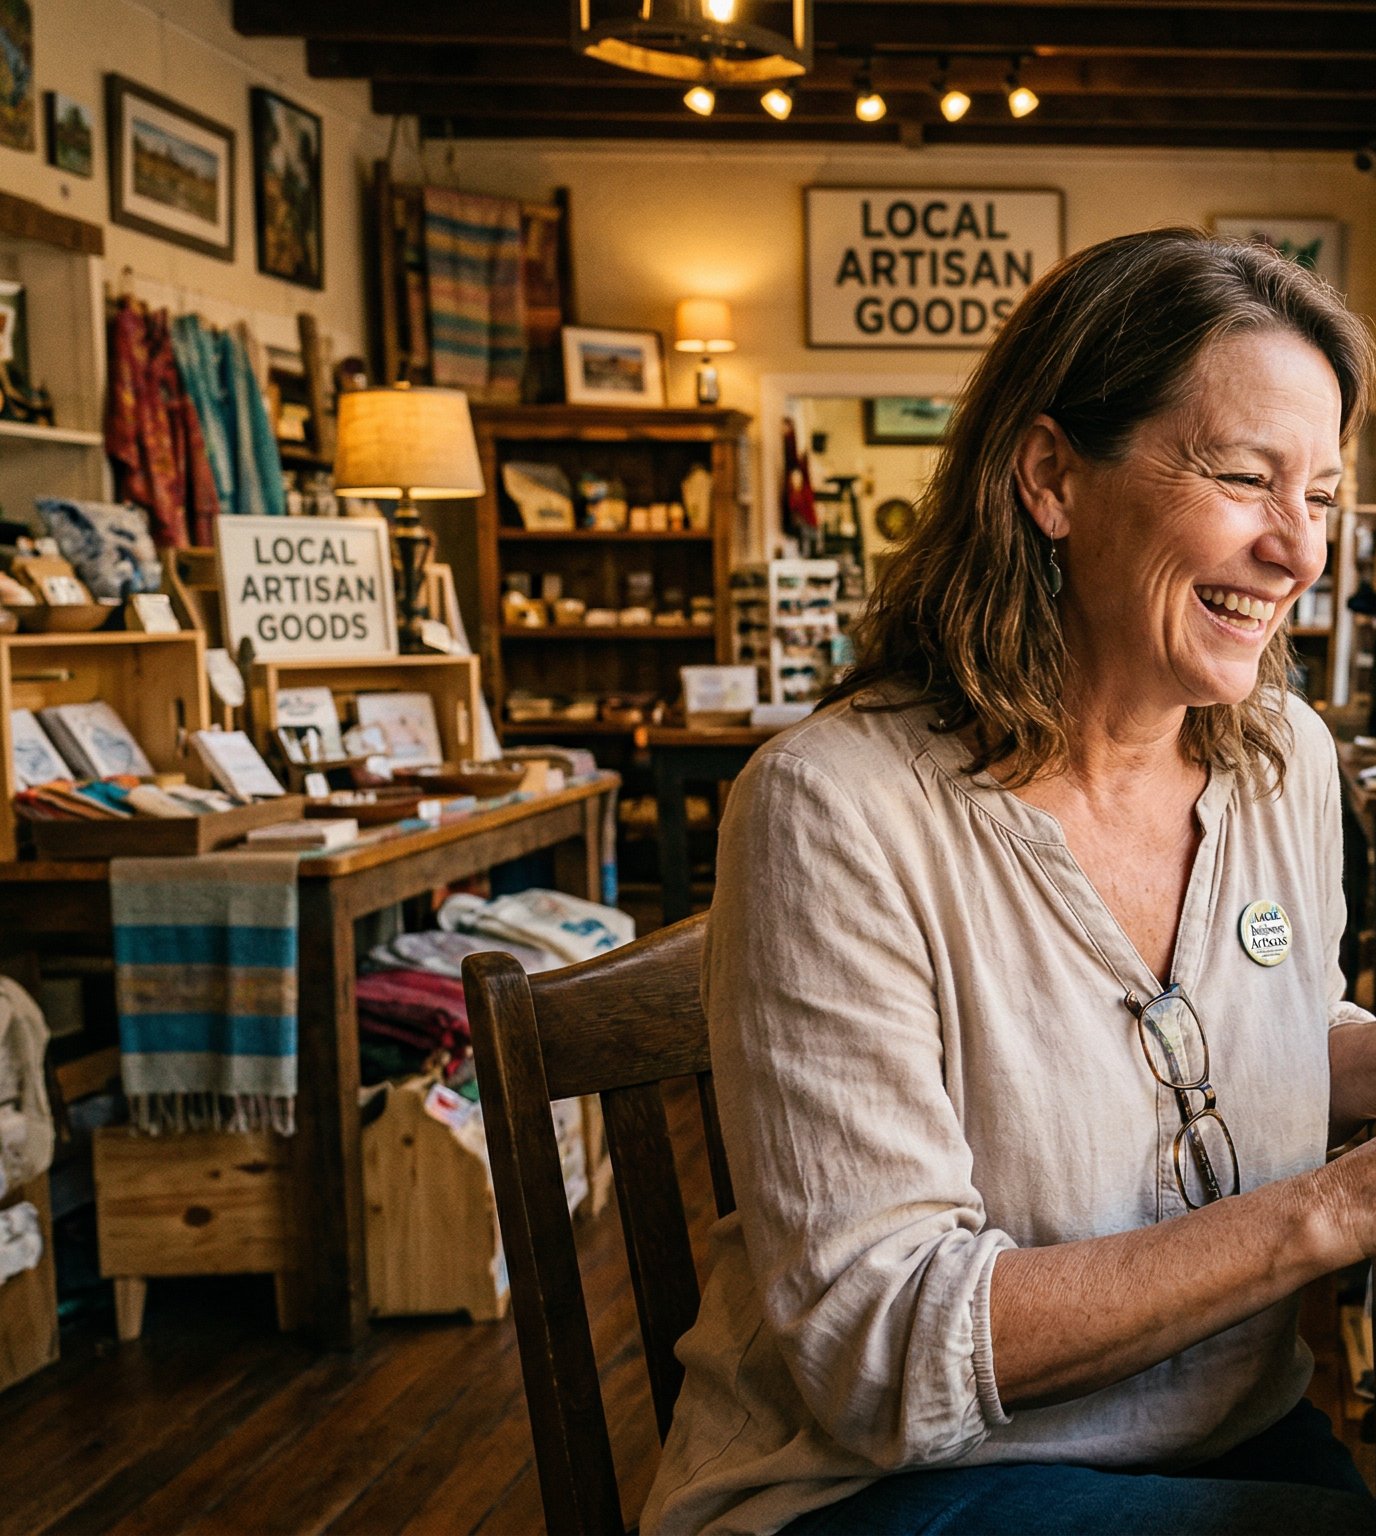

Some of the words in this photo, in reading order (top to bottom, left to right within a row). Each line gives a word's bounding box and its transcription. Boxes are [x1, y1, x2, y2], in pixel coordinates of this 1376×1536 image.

[861, 200, 1009, 240] LOCAL
[836, 249, 1033, 287] ARTISAN
[254, 537, 357, 565] LOCAL
[241, 575, 377, 604] ARTISAN
[257, 613, 369, 641] GOODS
